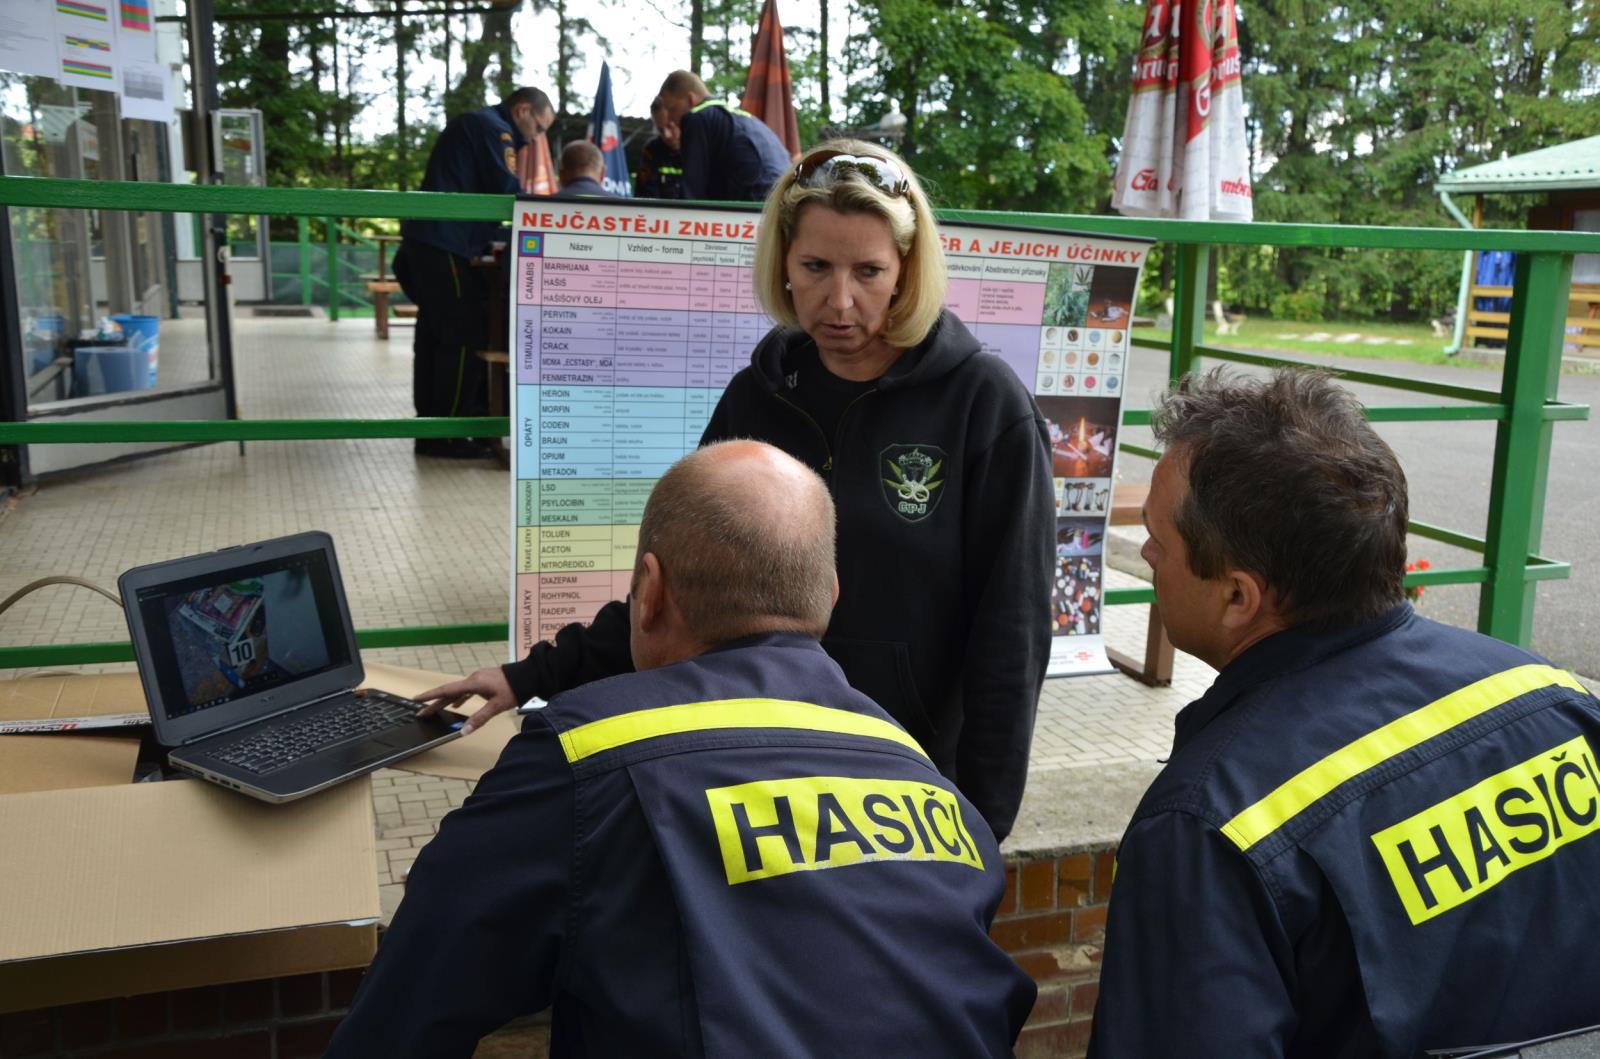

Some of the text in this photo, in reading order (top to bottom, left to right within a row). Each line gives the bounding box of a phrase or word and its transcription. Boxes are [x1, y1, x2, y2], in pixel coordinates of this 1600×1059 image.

[522, 211, 760, 239] NEJČASTĚJI ZNEUŽ
[569, 241, 593, 253] Název
[627, 243, 653, 254] Vzhled
[661, 245, 684, 255] forma
[968, 239, 981, 254] A
[988, 240, 1060, 259] JEJICH
[1067, 242, 1141, 264] ÚČINKY
[544, 262, 590, 272] MARIHUANA
[525, 262, 535, 300] CANABIS
[583, 296, 603, 304] OLEJ
[543, 310, 577, 319] PERVITIN
[543, 326, 572, 335] KOKAIN
[542, 342, 569, 350] CRACK
[542, 374, 594, 382] FENMETRAZIN
[542, 390, 570, 398] HEROIN
[542, 405, 570, 413] MORFIN
[542, 421, 570, 429] CODEIN
[542, 437, 568, 445] BRAUN
[541, 452, 565, 460] OPIUM
[541, 468, 577, 476] METADON
[541, 484, 556, 492] LSD
[541, 499, 585, 507] PSYLOCIBIN
[541, 530, 570, 538] TOLUEN
[541, 546, 571, 554] ACETON
[541, 576, 578, 585] DIAZEPAM
[541, 591, 581, 600] ROHYPNOL
[541, 607, 576, 615] RADEPUR
[232, 642, 253, 663] 10
[729, 788, 976, 873] HASIČI
[1396, 750, 1600, 910] HASIČI
